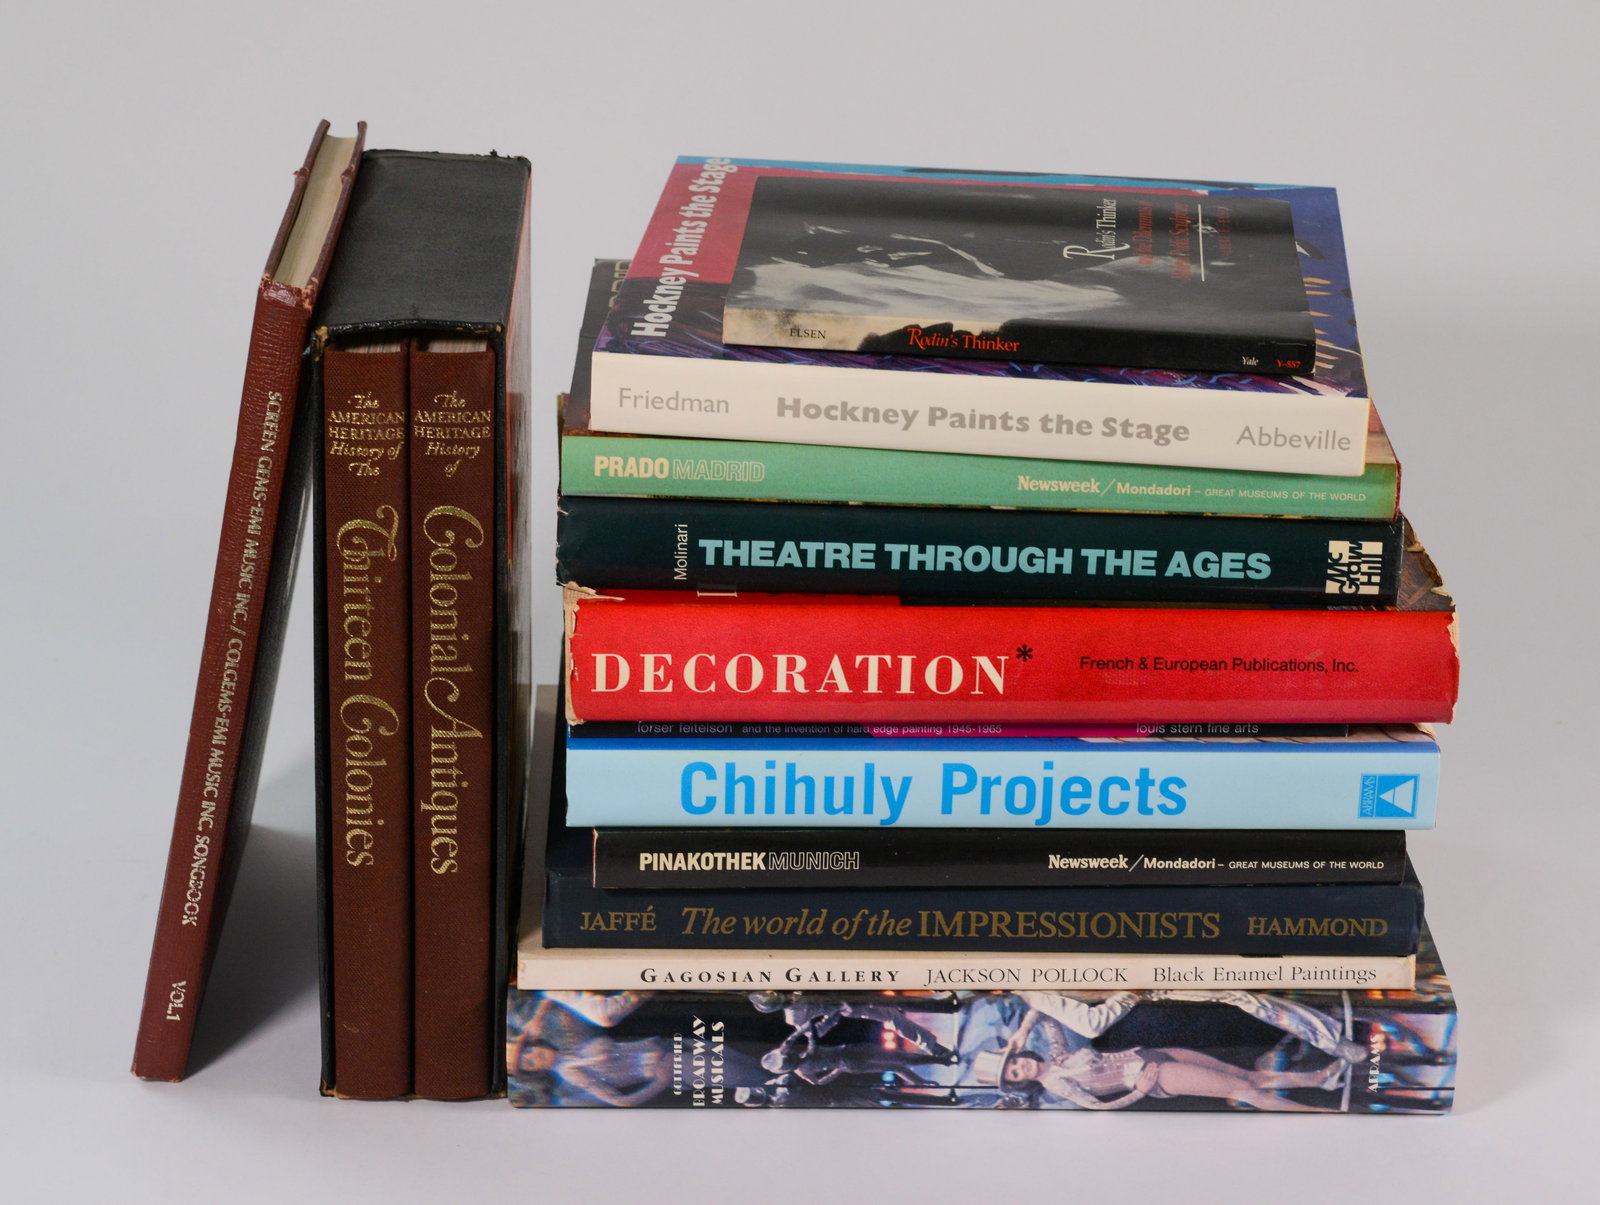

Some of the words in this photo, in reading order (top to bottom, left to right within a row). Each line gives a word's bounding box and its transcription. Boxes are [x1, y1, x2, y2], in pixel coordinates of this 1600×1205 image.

[688, 158, 738, 194] Stage
[679, 195, 717, 218] the
[1095, 199, 1117, 229] Thinker
[659, 220, 707, 265] Paints
[631, 267, 699, 337] Hockney
[789, 328, 827, 340] ELSEN
[907, 327, 958, 349] Rodin's
[963, 333, 1020, 352] Thinker
[1242, 356, 1259, 366] Yale
[347, 391, 380, 409] The
[434, 390, 466, 408] The
[618, 387, 730, 414] Friedman
[259, 391, 282, 452] SCREEN
[328, 410, 405, 424] AMERICAN
[414, 410, 491, 423] AMERICAN
[777, 397, 920, 432] Hockney
[928, 405, 1030, 433] Paints
[1039, 413, 1094, 436] the
[1100, 416, 1190, 446] Stage
[328, 426, 405, 441] HERITAGE
[414, 424, 491, 439] HERITAGE
[1235, 425, 1352, 451] Abbeville
[330, 440, 384, 460] History
[387, 440, 405, 460] of
[425, 441, 480, 459] History
[348, 459, 380, 476] The
[444, 458, 462, 478] of
[594, 455, 669, 478] PRADO
[673, 458, 765, 482] MADRID
[1204, 486, 1235, 498] GREAT
[1238, 488, 1288, 499] MUSEUMS
[1292, 490, 1305, 499] OF
[1309, 491, 1327, 500] THE
[1330, 491, 1366, 501] WORLD
[238, 538, 260, 589] MUSIC
[673, 523, 689, 580] Molinari
[699, 539, 876, 570] THEATRE
[884, 542, 1073, 575] THROUGH
[1081, 548, 1158, 577] THE
[1165, 550, 1272, 580] AGES
[337, 504, 399, 681] Thirteen
[423, 505, 484, 675] Colonial
[1080, 655, 1134, 671] French
[1138, 656, 1149, 671] &
[1153, 657, 1228, 673] European
[1232, 657, 1329, 675] Publications,
[1332, 658, 1360, 674] Inc.
[679, 721, 733, 734] feitelson
[742, 723, 761, 734] and
[765, 723, 781, 734] the
[784, 722, 830, 734] invention
[834, 723, 844, 734] of
[847, 723, 870, 734] hard
[873, 724, 899, 737] edge
[902, 723, 943, 737] painting
[947, 724, 1003, 735] 1945-1965
[1136, 722, 1166, 734] louis
[1170, 723, 1202, 734] stern
[1207, 722, 1230, 734] fine
[1234, 723, 1260, 734] arts
[203, 747, 224, 798] MUSIC
[340, 694, 400, 867] Colonies
[420, 677, 483, 875] Antiques
[681, 760, 912, 826] Chihuly
[941, 760, 1188, 826] Projects
[639, 851, 766, 871] PINAKOTHEK
[768, 851, 860, 871] MUNICH
[1229, 860, 1258, 870] GREAT
[1261, 860, 1309, 870] MUSEUMS
[1313, 860, 1326, 869] OF
[1329, 860, 1347, 869] THE
[1350, 860, 1385, 869] WORLD
[580, 905, 657, 932] JAFFÉ
[681, 907, 736, 935] The
[743, 908, 826, 936] world
[831, 908, 872, 941] of
[868, 909, 912, 937] the
[918, 910, 1221, 939] IMPRESSIONISTS
[1247, 916, 1389, 937] HAMMOND
[640, 967, 772, 984] GAGOSIAN
[785, 966, 900, 983] GALLERY
[923, 967, 1021, 987] JACKSON
[1032, 966, 1128, 983] POLLOCK
[1153, 966, 1204, 982] Black
[1213, 966, 1283, 982] Enamel
[1291, 966, 1377, 986] Paintings
[673, 1033, 683, 1096] GOTTFRIED
[692, 1015, 706, 1107] BROADWAY
[710, 1021, 725, 1105] MUSICALS
